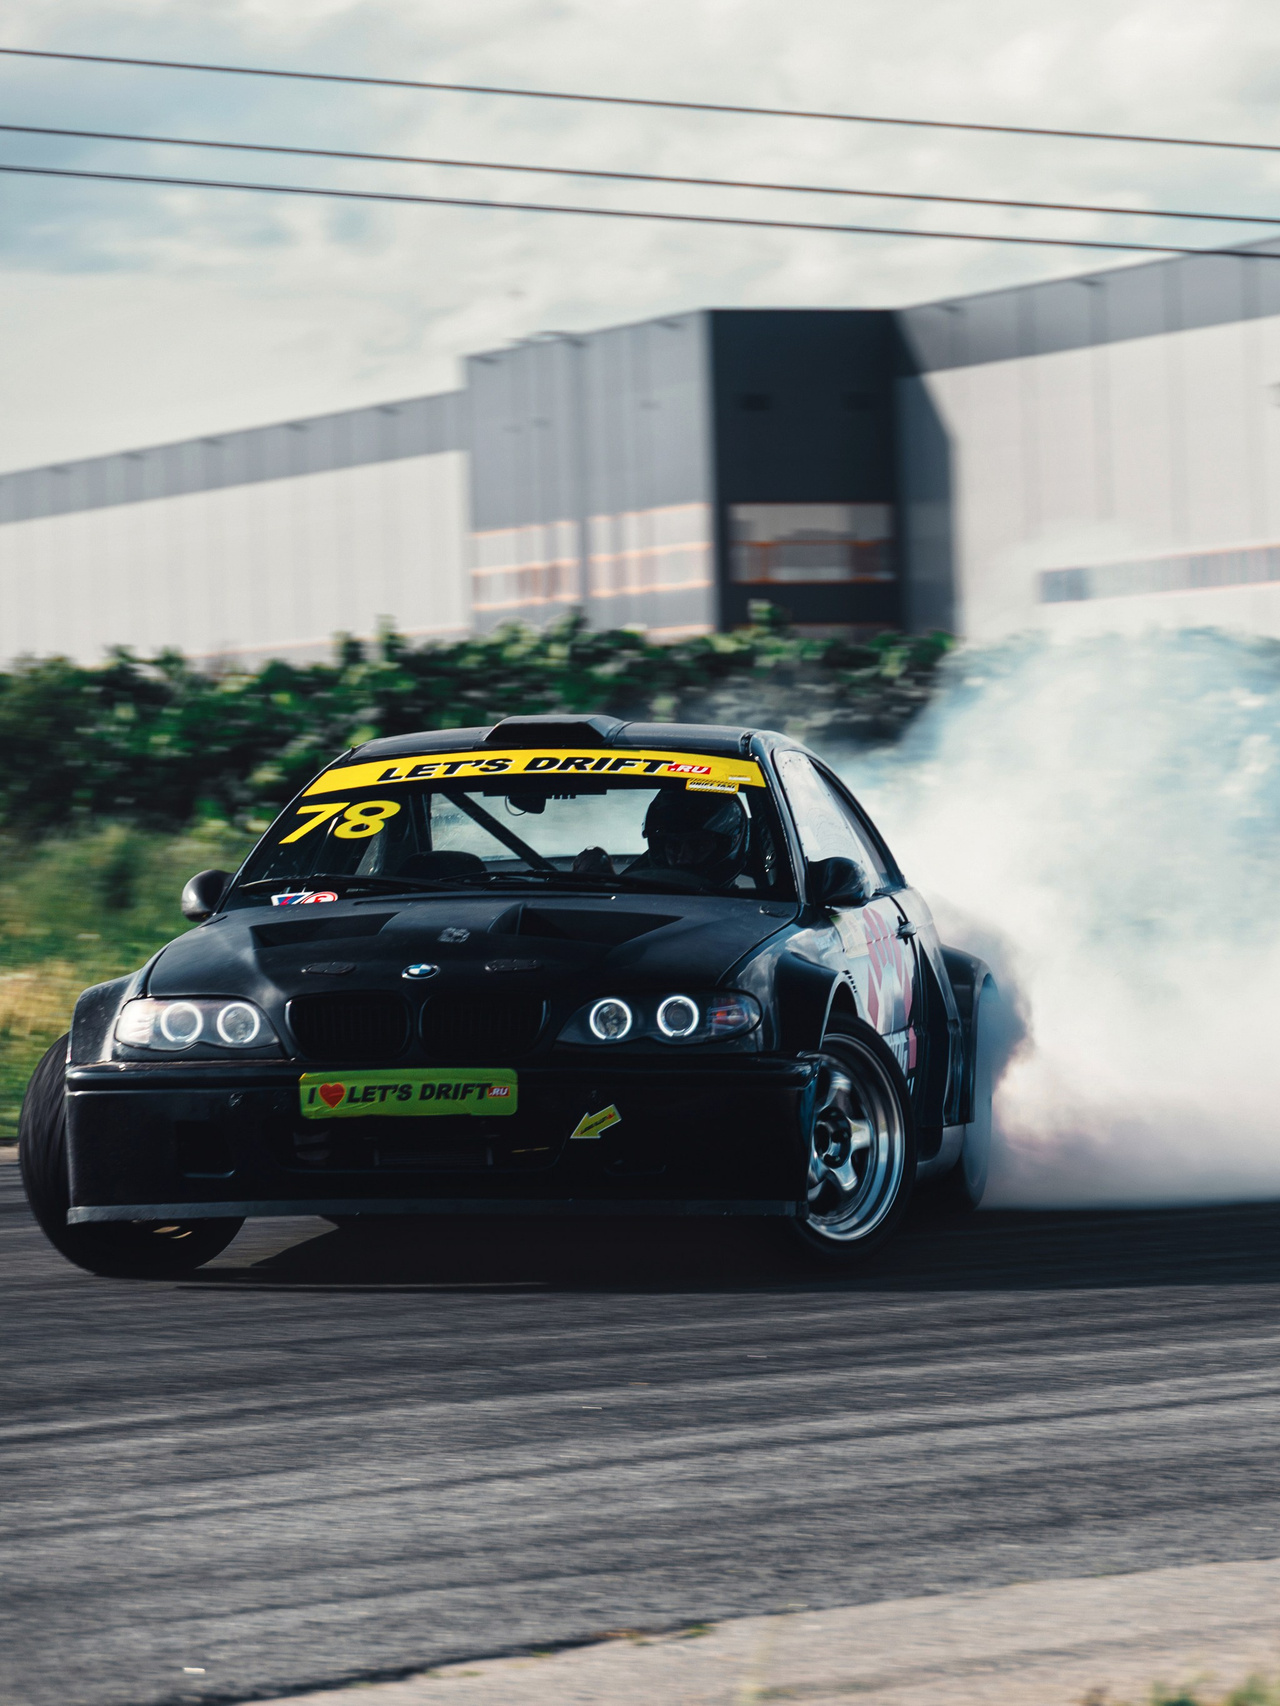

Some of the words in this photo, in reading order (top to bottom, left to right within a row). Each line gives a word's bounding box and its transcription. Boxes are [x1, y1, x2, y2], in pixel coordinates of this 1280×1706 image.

[376, 758, 515, 782] LET'S
[278, 800, 401, 844] 78
[307, 1087, 317, 1104] I
[346, 1084, 413, 1104] LET'S
